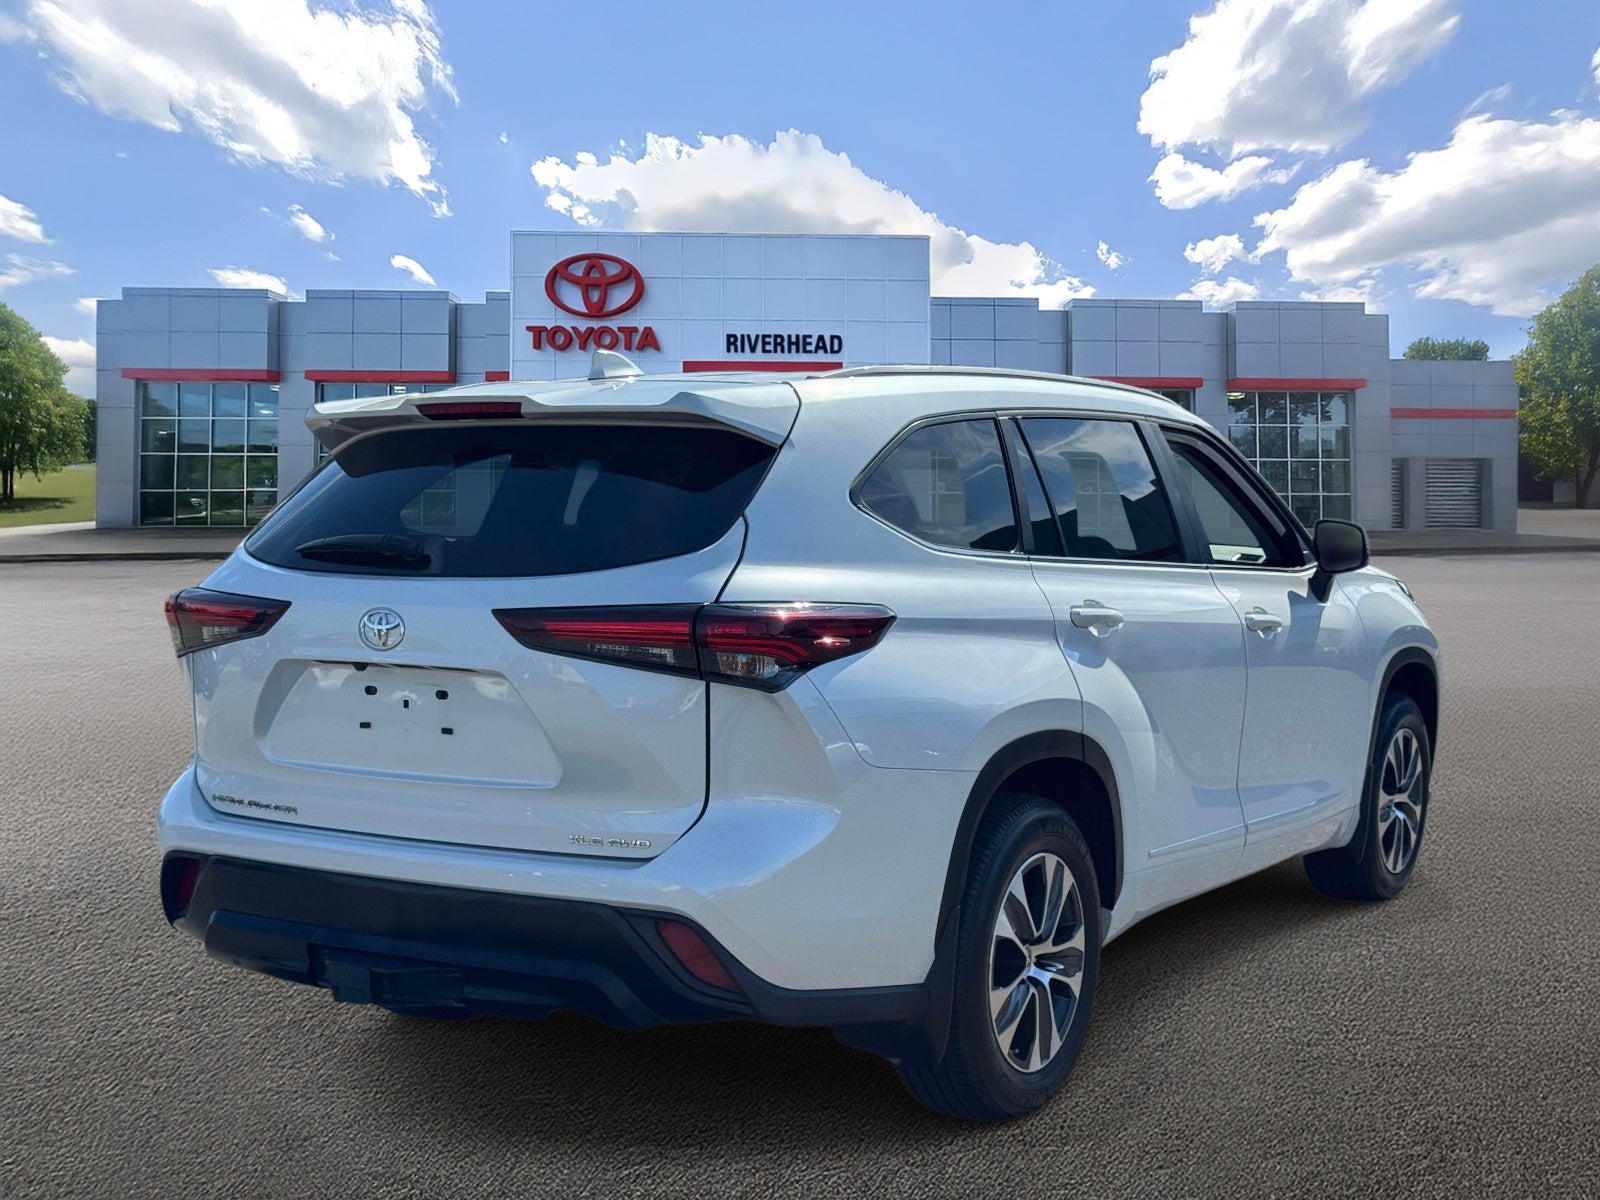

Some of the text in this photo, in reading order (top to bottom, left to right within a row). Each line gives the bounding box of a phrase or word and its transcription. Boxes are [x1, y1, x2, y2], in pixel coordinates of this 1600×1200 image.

[525, 325, 661, 351] TOYOTA
[726, 333, 843, 354] RIVERHEAD
[212, 793, 298, 815] HIGHAER
[568, 833, 604, 847] XLE
